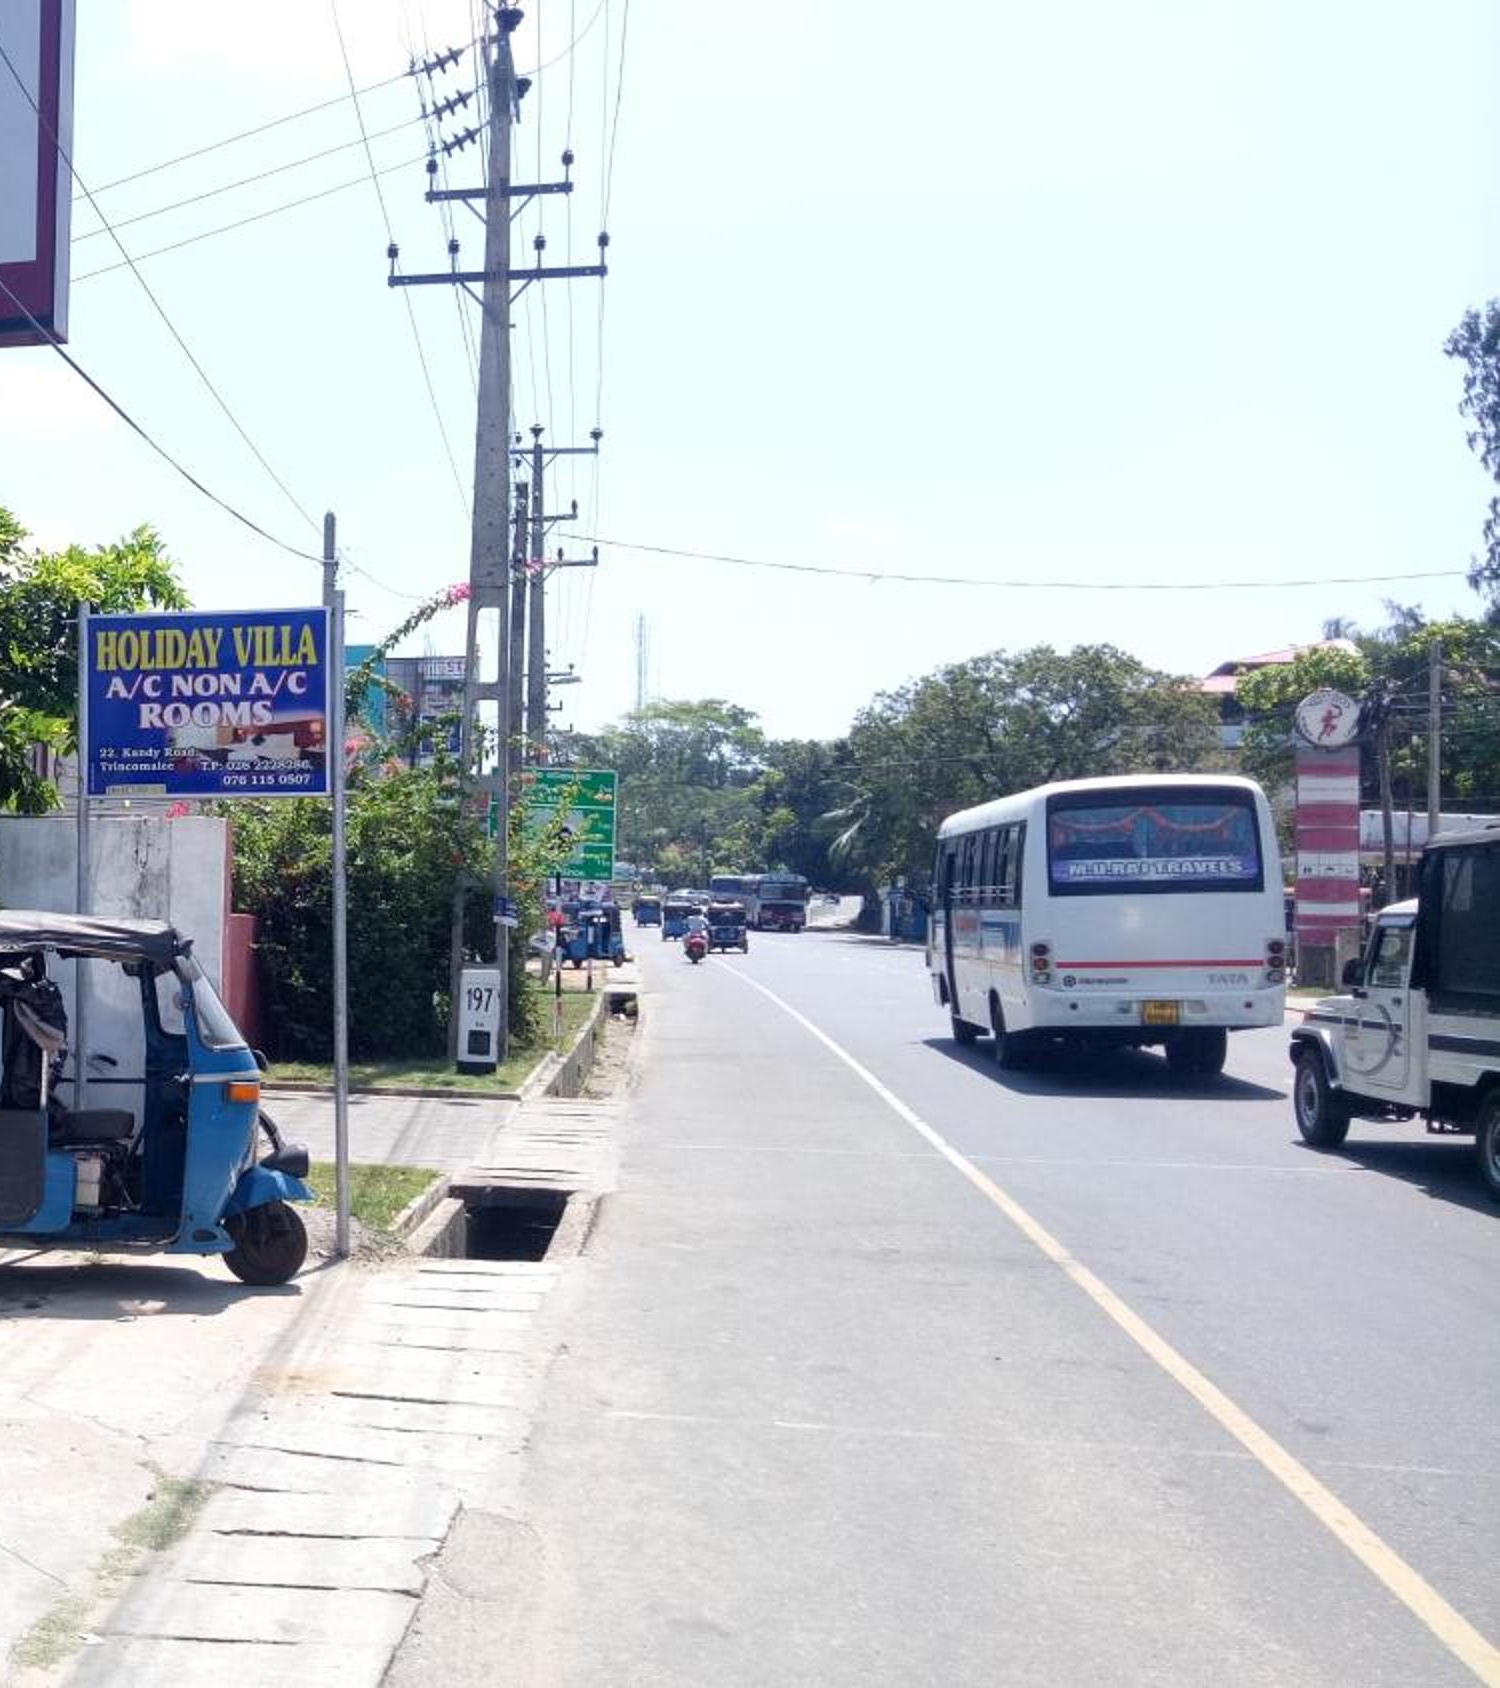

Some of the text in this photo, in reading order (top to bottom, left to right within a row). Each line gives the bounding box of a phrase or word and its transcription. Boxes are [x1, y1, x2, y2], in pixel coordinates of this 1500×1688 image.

[96, 624, 318, 671] HOLIDAY VILLA
[105, 670, 308, 700] A/C NON A/C
[138, 701, 274, 729] ROOMS
[122, 747, 161, 760] Kandy
[100, 761, 175, 772] Trincomalee
[1156, 860, 1243, 874] TRAVELS
[1207, 973, 1249, 985] TATA
[467, 987, 493, 1013] 197
